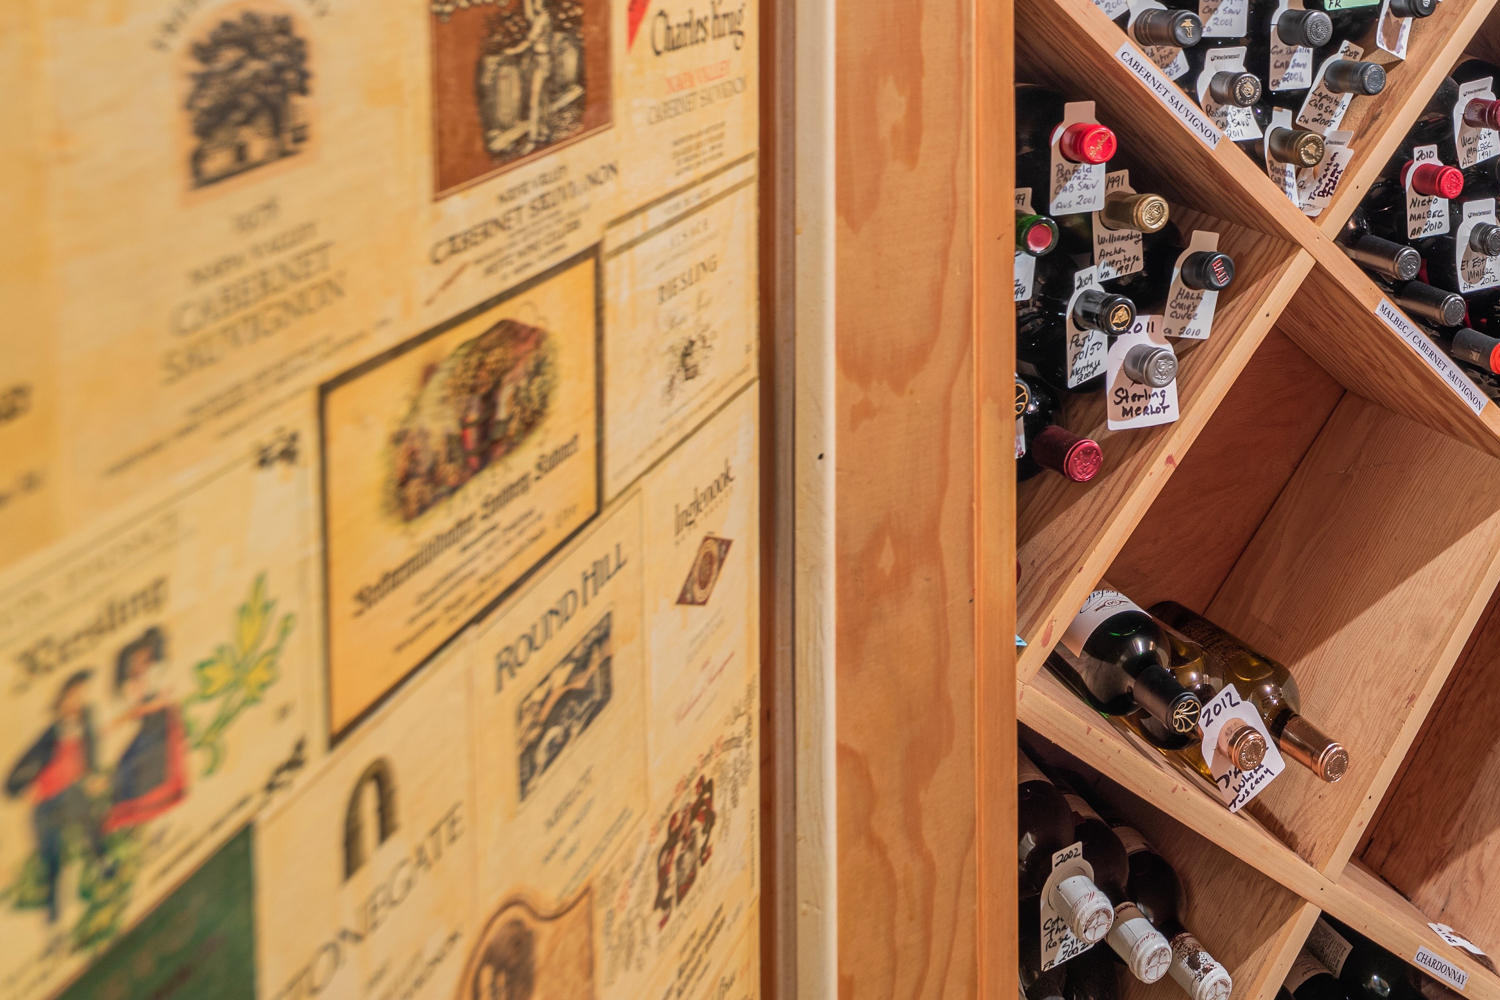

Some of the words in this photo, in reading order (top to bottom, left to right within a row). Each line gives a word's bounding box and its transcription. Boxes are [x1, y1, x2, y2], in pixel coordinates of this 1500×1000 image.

[651, 7, 709, 57] Charles
[1119, 49, 1172, 101] CABERNET
[1167, 96, 1222, 147] SAUVIGNON
[1415, 148, 1436, 163] 2010
[657, 253, 720, 306] RIESLING
[1379, 303, 1408, 335] MALBEC
[1411, 337, 1450, 373] CABERNET
[1447, 371, 1486, 412] SAUVIGNON
[1112, 386, 1168, 408] Sterling
[674, 457, 736, 538] Inglenook
[494, 588, 580, 696] ROUND
[580, 542, 629, 609] HILL
[1201, 690, 1241, 728] 2012
[1415, 949, 1469, 988] CHARDONNAY
